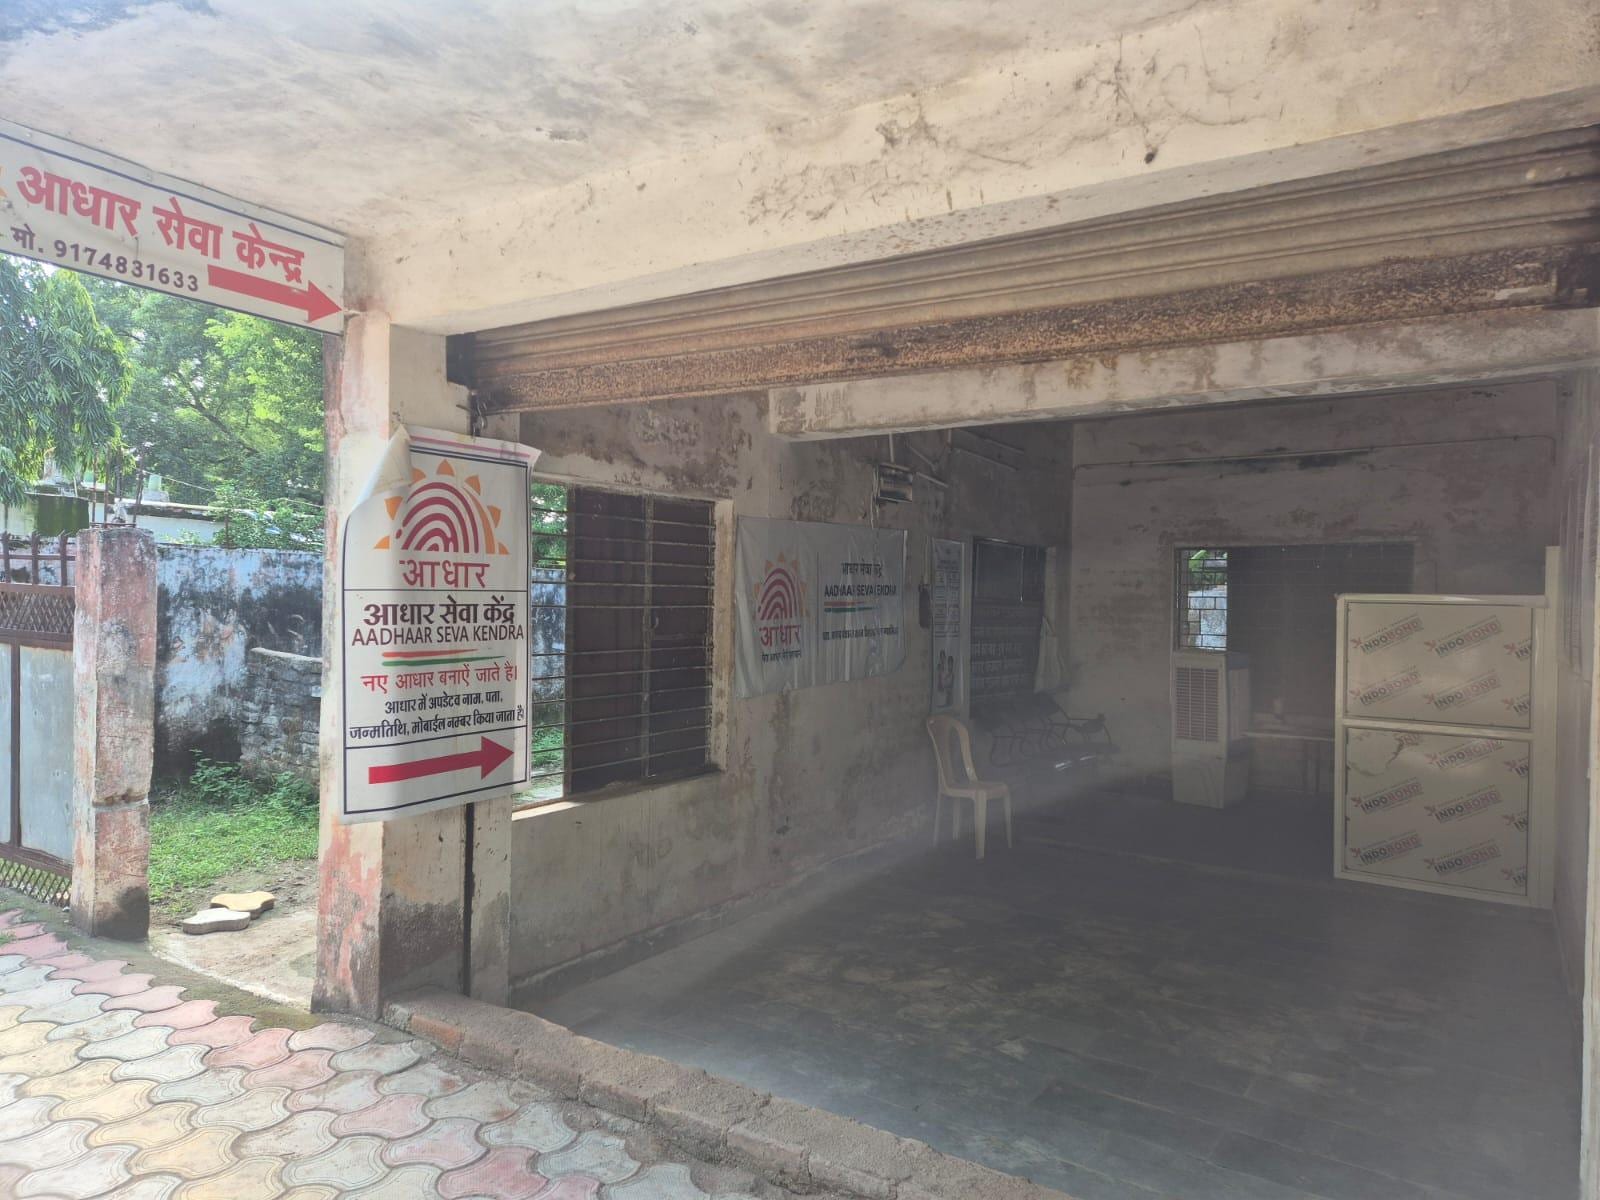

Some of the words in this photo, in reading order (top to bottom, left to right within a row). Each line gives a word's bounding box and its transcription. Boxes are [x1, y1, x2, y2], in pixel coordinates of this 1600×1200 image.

[16, 166, 142, 237] आधार
[153, 197, 223, 260] सेवा
[232, 223, 305, 283] केन्द्र
[10, 223, 44, 254] मो.
[54, 239, 199, 293] 9174831633
[399, 559, 490, 588] आधार
[363, 603, 435, 626] आधार
[439, 594, 478, 624] सेवा
[483, 595, 515, 624] केंद्र
[351, 626, 433, 647] AADHAAR
[436, 626, 469, 643] SEVA
[473, 624, 524, 642] KENDRA
[758, 624, 801, 647] आधार
[361, 675, 388, 694] नए
[395, 671, 434, 690] आधार
[475, 662, 501, 684] जाते
[384, 698, 416, 714] आधार
[417, 692, 428, 711] में
[473, 709, 494, 726] किया
[496, 710, 515, 724] जाता
